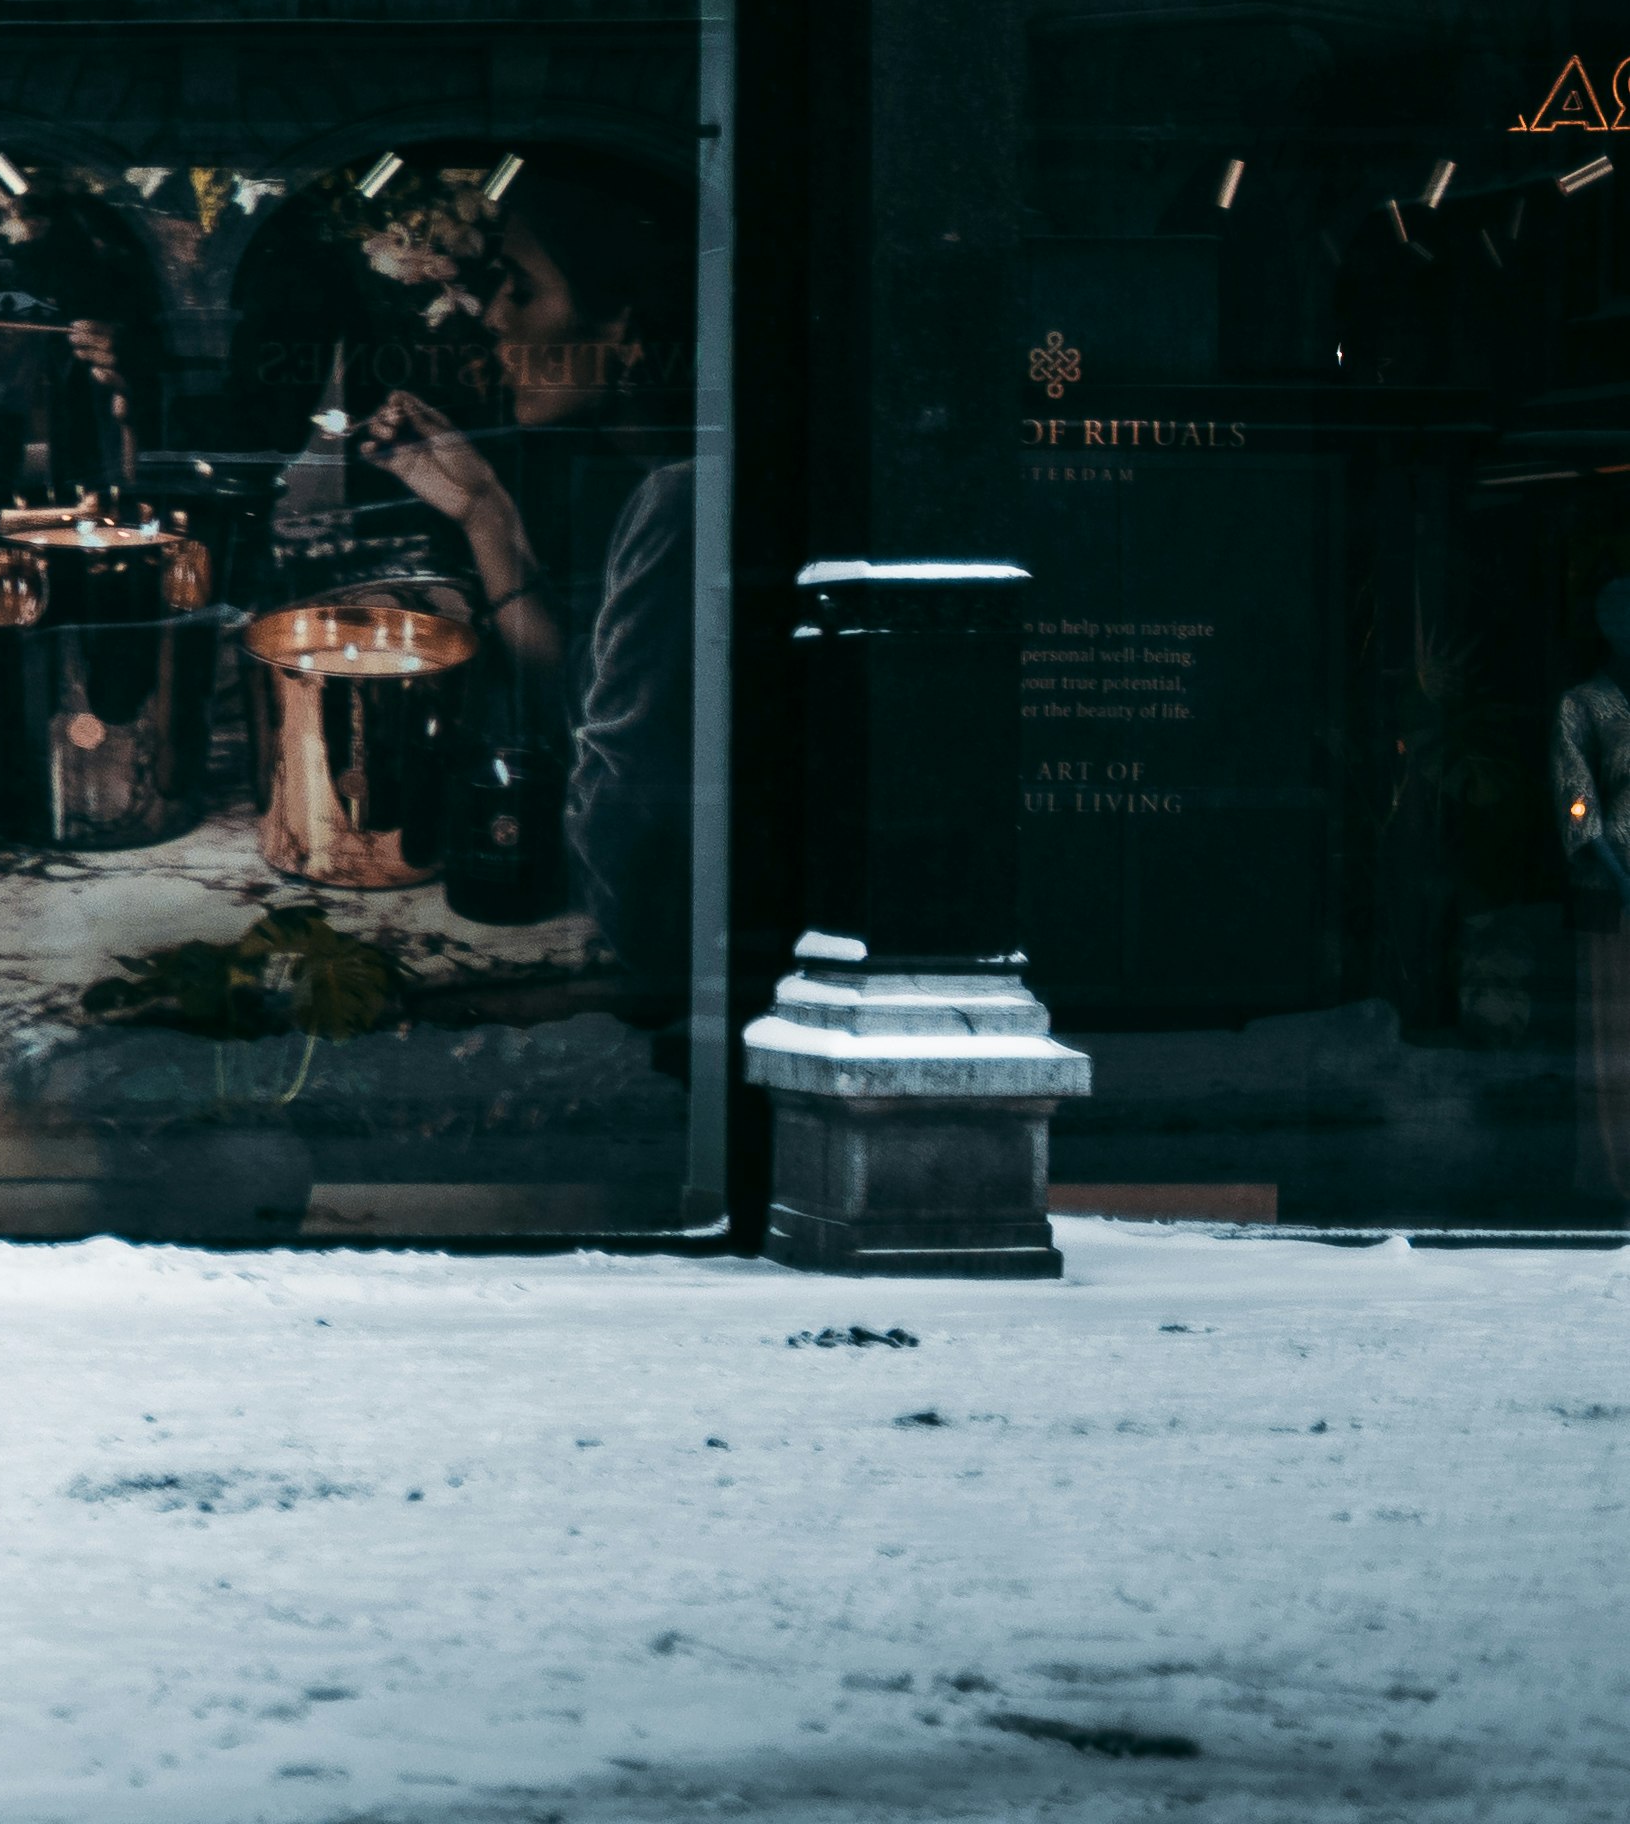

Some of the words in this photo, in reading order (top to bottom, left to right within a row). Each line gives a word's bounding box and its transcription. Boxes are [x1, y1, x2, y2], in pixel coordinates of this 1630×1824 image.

[1083, 419, 1248, 447] RITUALS
[1061, 618, 1099, 638] help
[1103, 622, 1136, 638] you
[1140, 621, 1215, 640] navigate
[1021, 647, 1096, 665] personal
[1061, 676, 1098, 690] true
[1043, 702, 1072, 718] the
[1075, 701, 1135, 722] beauty
[1139, 702, 1161, 719] of
[1036, 760, 1095, 782] ART
[1106, 760, 1146, 782] OF
[1075, 791, 1183, 815] LIVING
